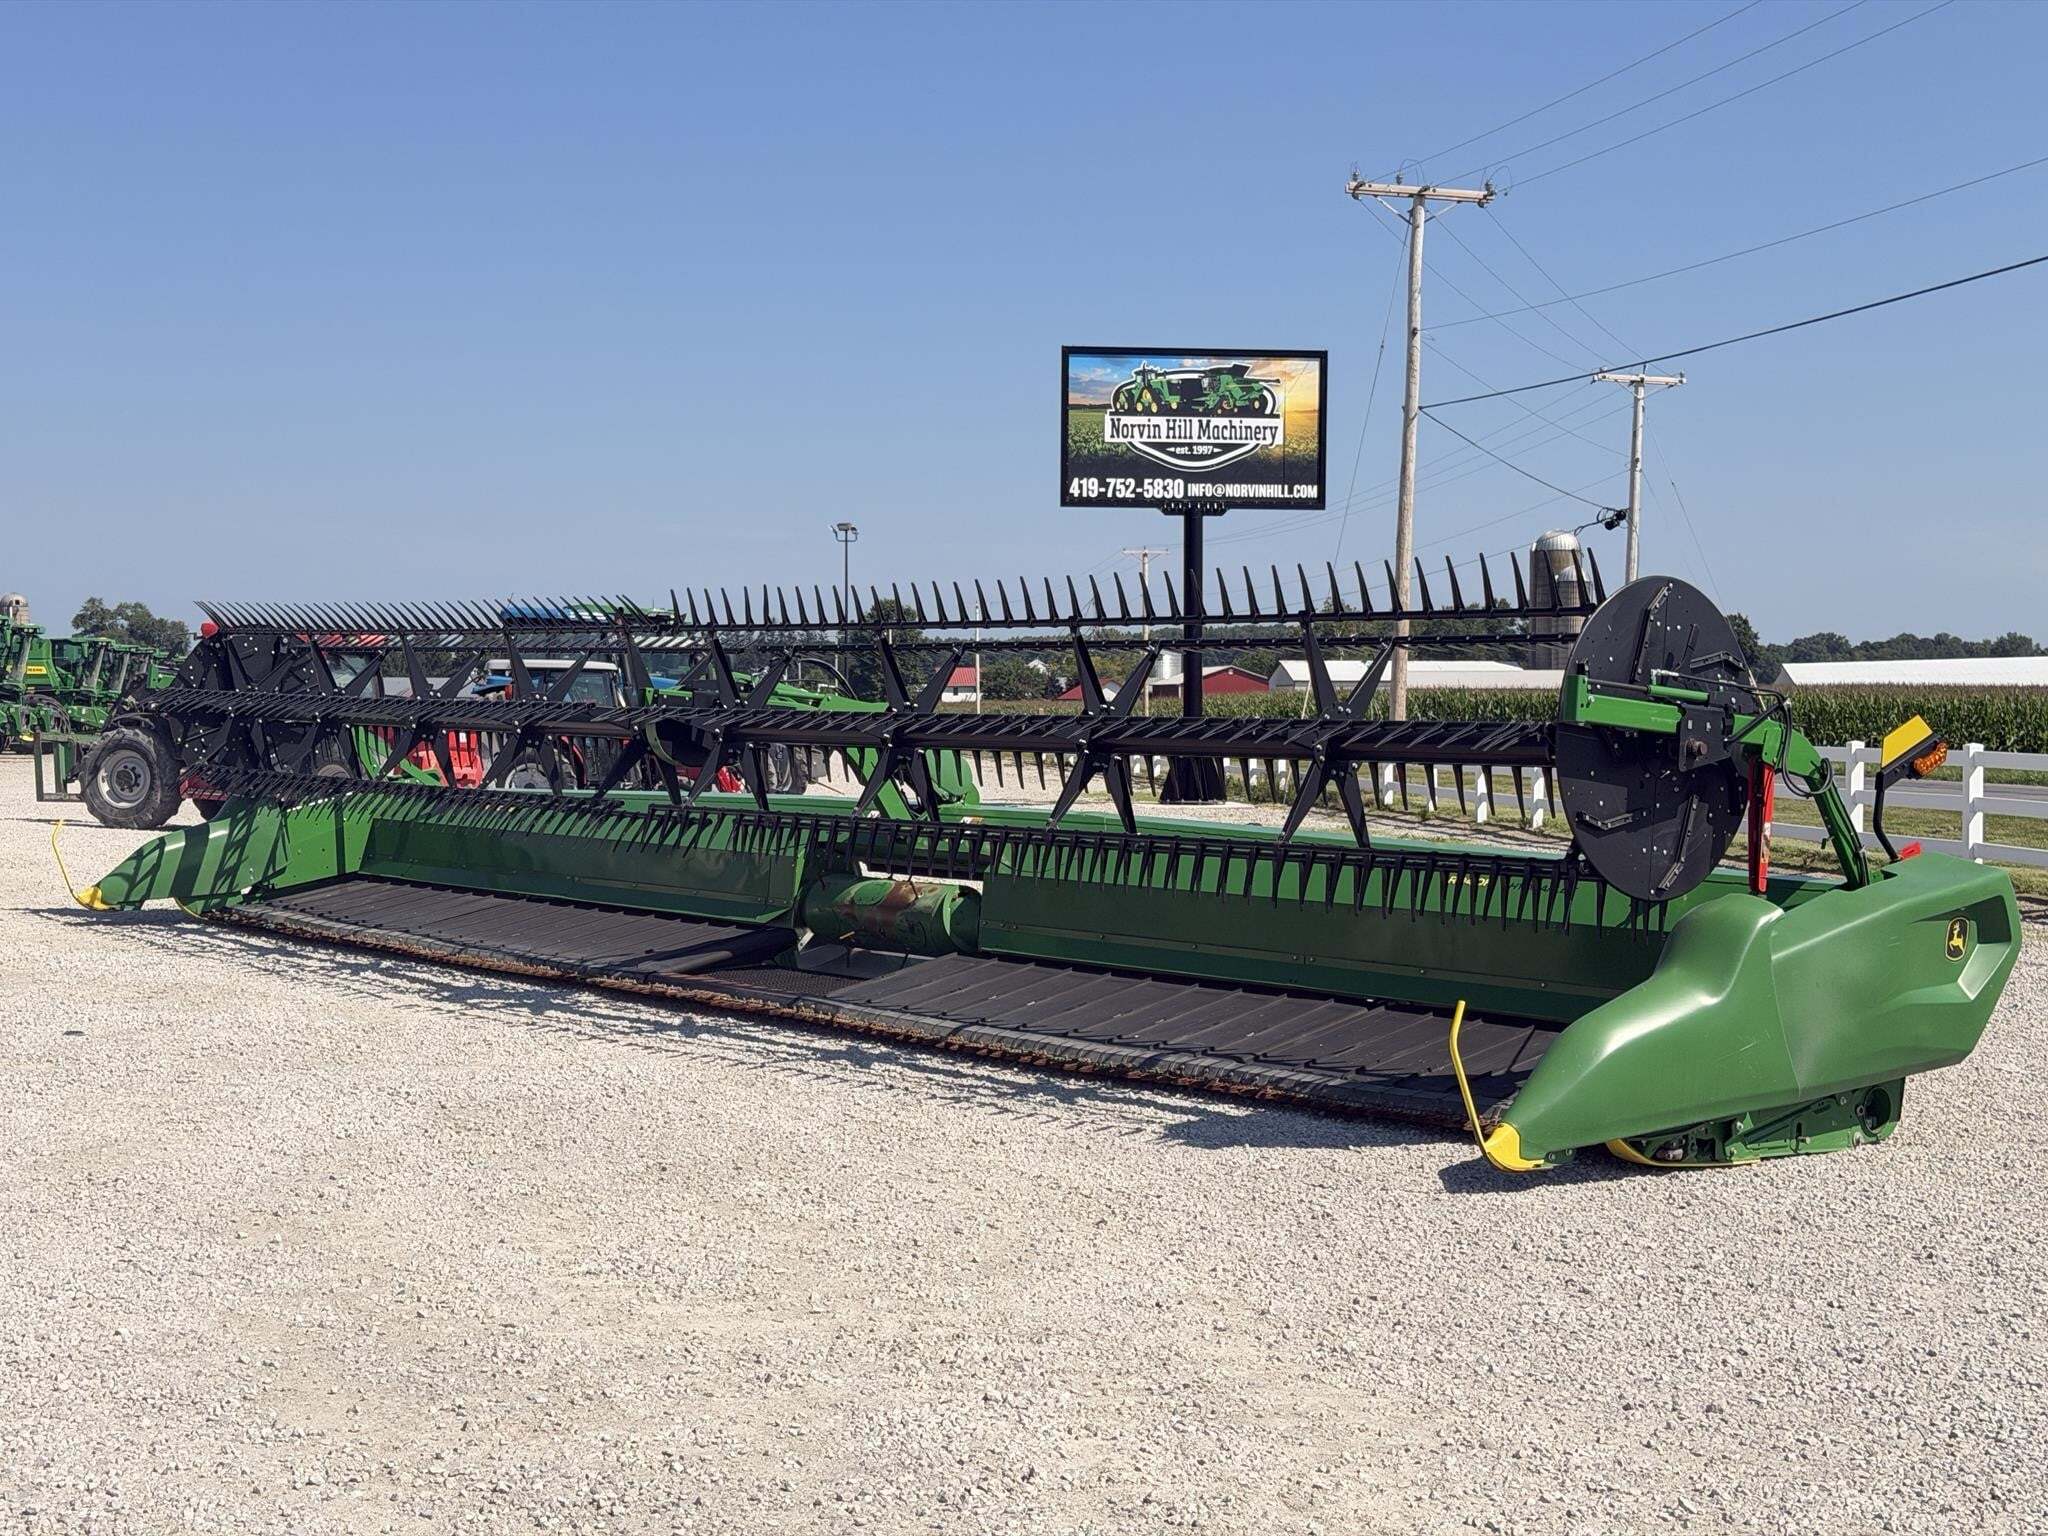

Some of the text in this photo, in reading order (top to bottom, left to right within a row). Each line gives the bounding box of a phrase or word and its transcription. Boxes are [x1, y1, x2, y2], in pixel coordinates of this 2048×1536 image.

[1110, 418, 1278, 444] Norvin Hill Machinery
[1176, 445, 1213, 455] est. 1997
[1069, 477, 1318, 499] 419-752-5830 INFO@NORVINHILL.COM
